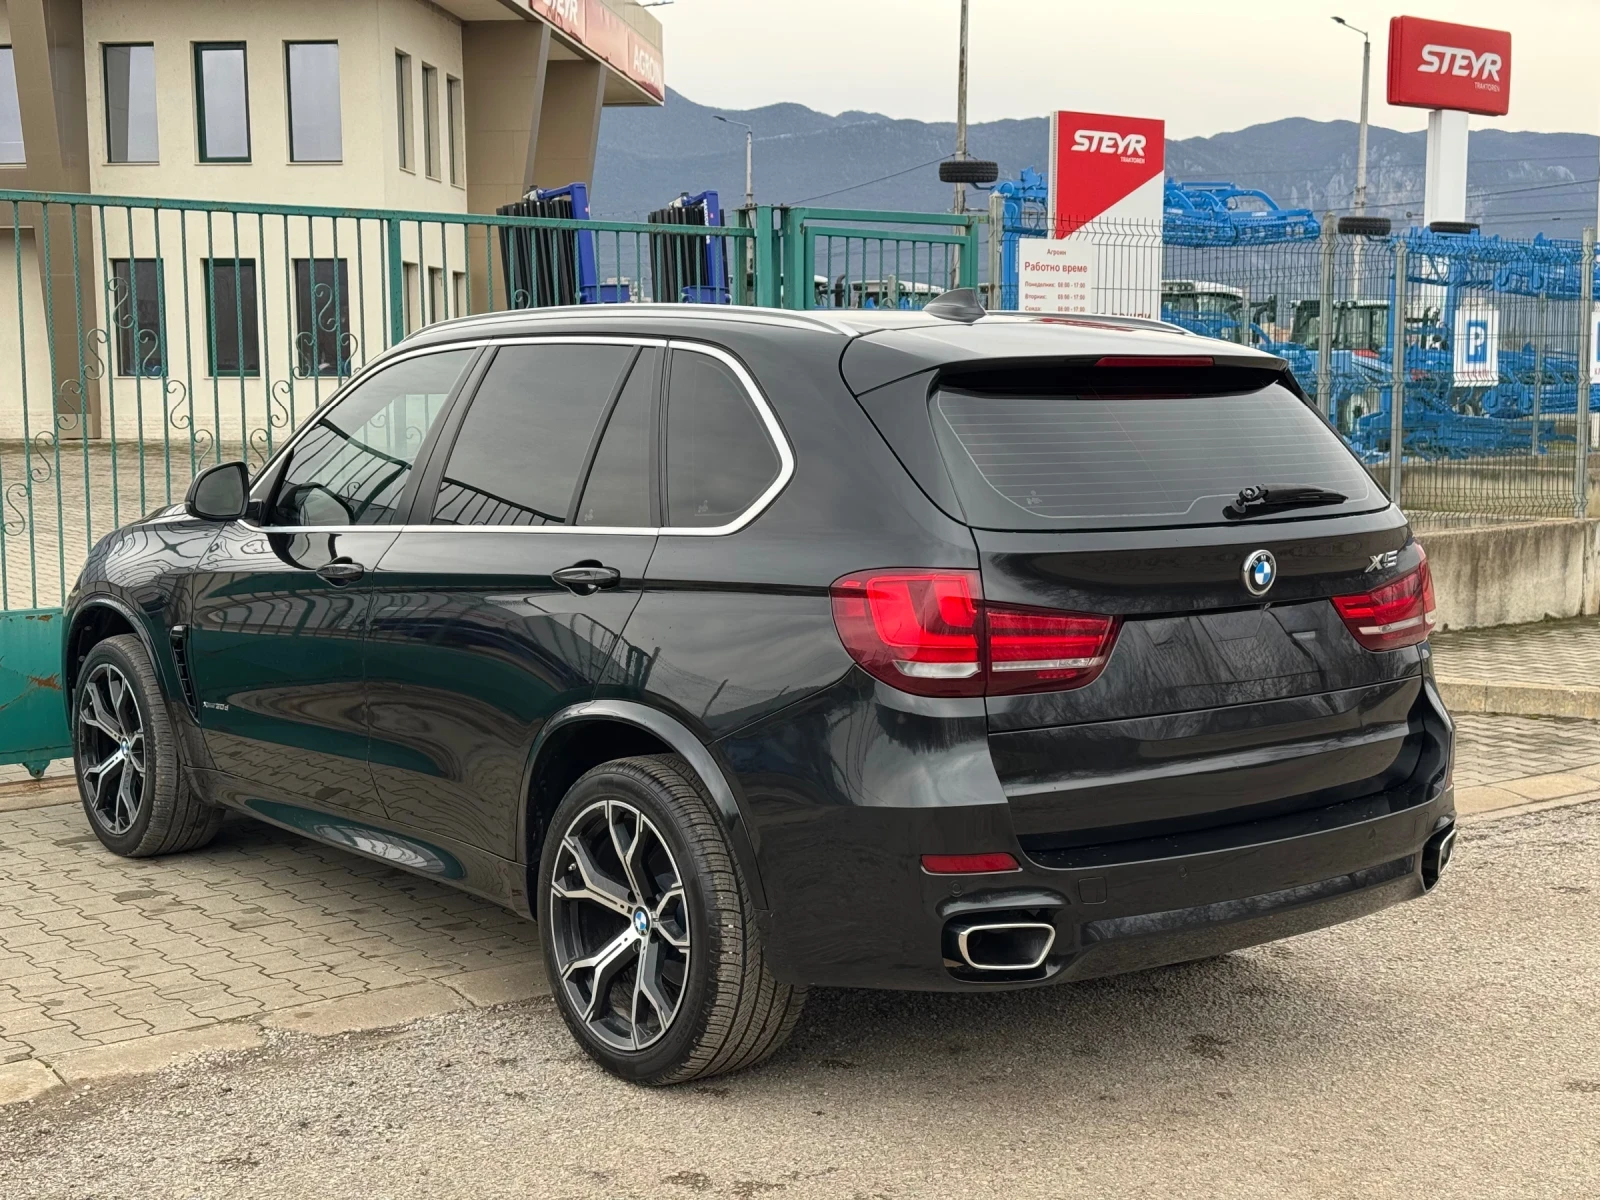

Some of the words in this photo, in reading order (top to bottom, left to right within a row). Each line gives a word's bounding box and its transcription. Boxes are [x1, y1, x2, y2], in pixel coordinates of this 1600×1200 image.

[1417, 44, 1502, 82] STEYR
[1070, 129, 1147, 156] STEYR
[1024, 261, 1060, 272] Работно
[1062, 264, 1088, 275] време
[1364, 550, 1398, 573] X5
